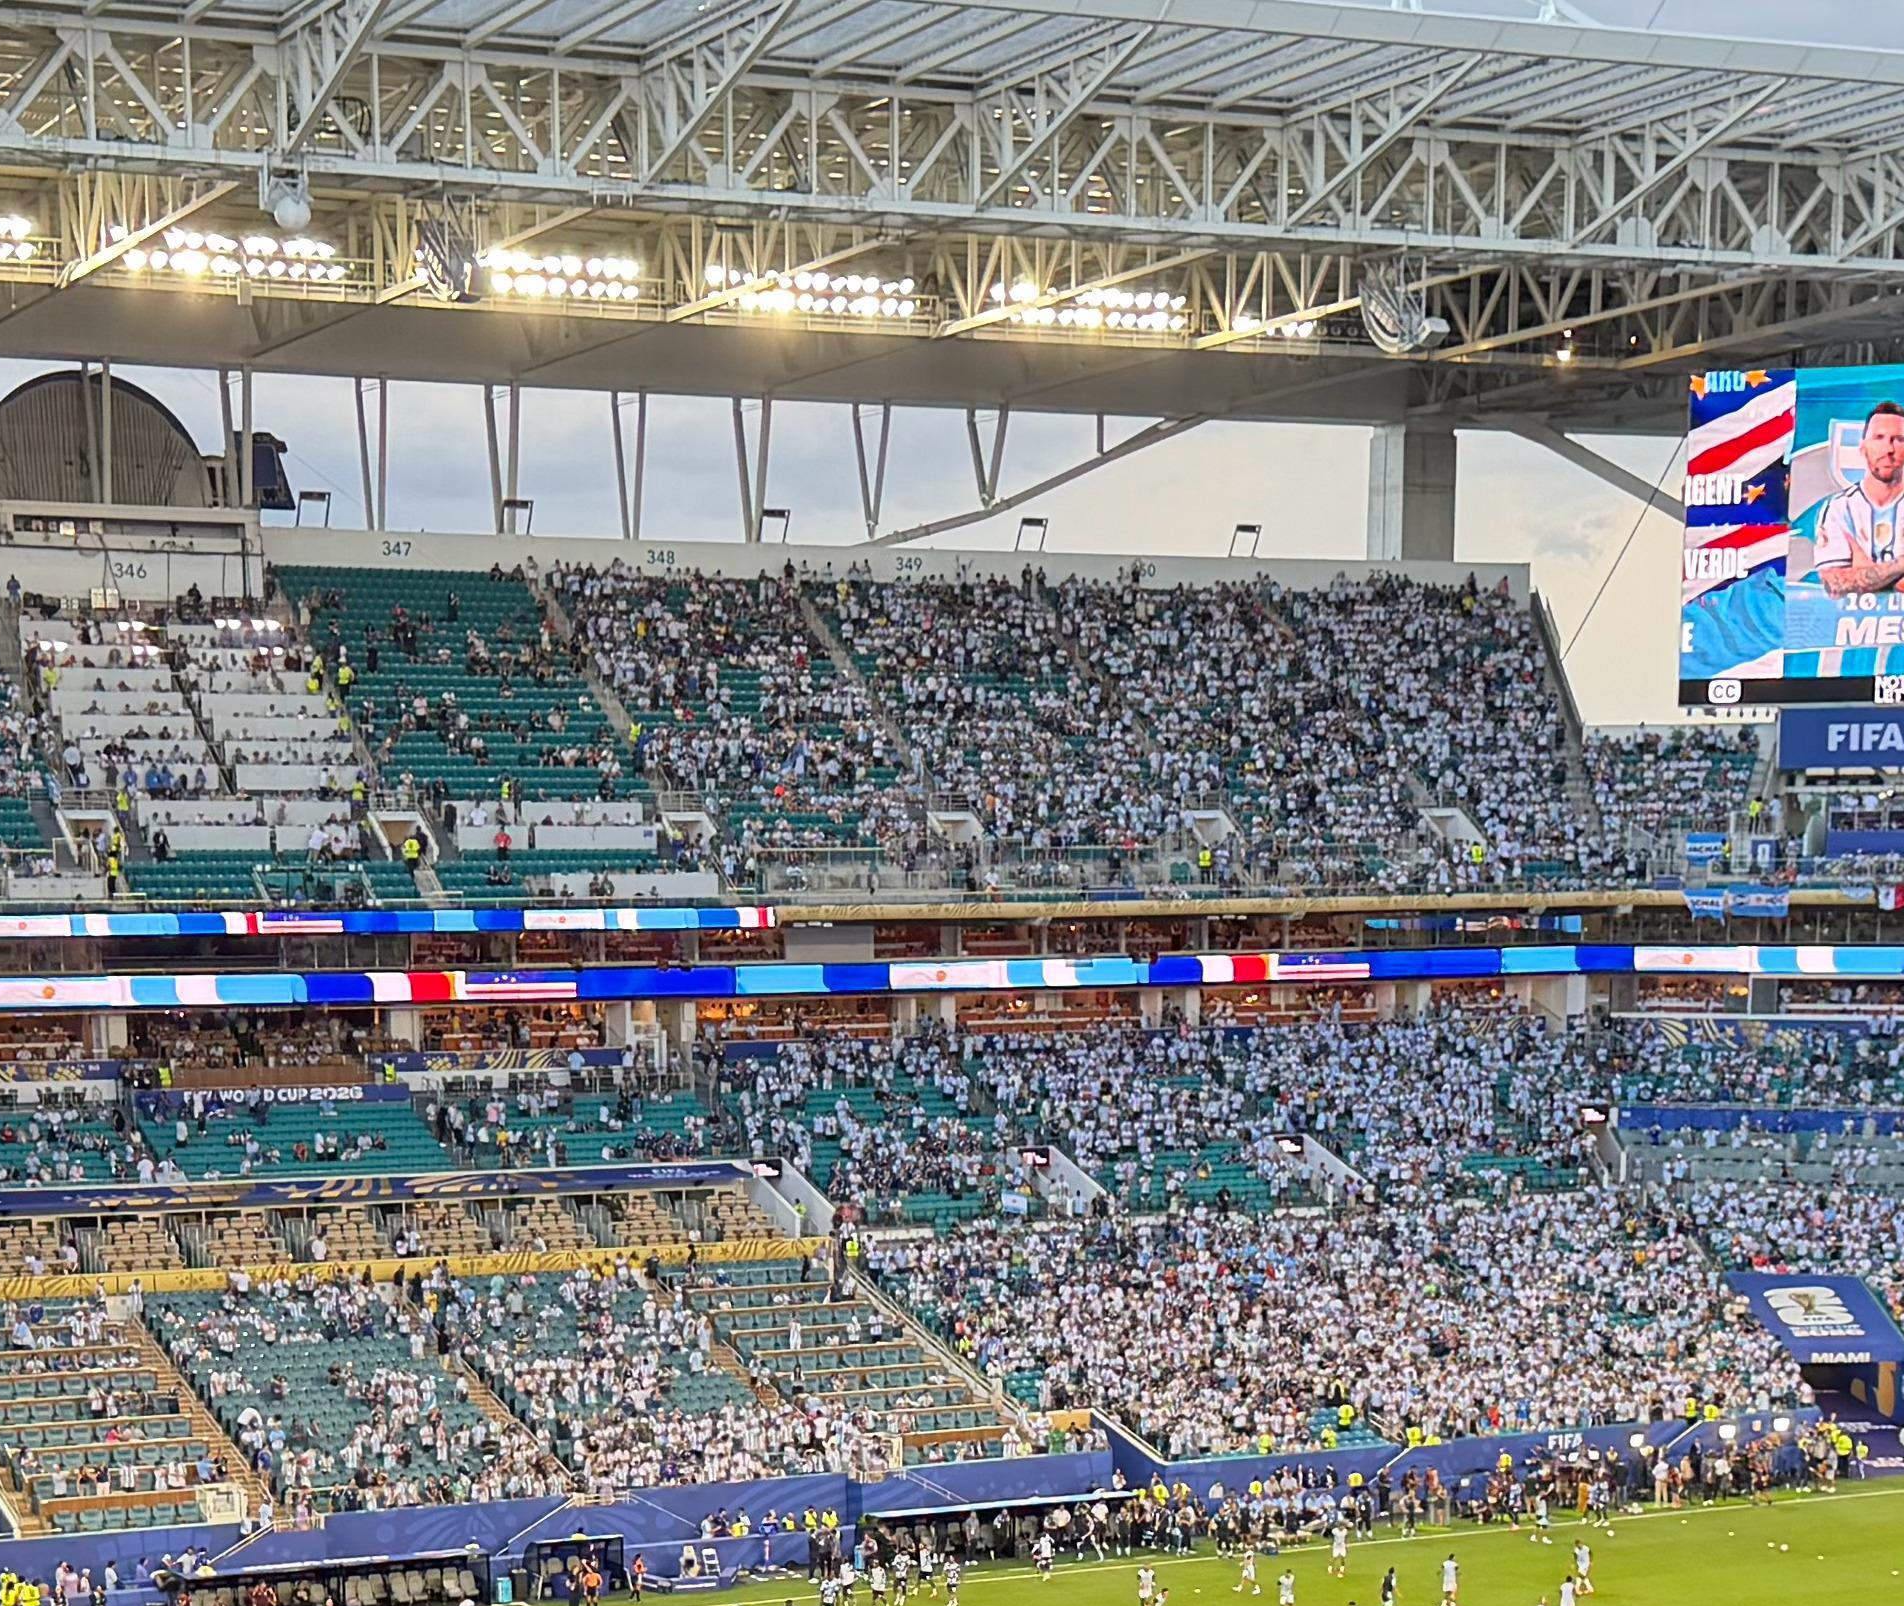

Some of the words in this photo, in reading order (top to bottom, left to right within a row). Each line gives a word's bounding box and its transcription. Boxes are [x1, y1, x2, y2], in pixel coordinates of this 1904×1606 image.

[382, 541, 411, 556] 347
[647, 550, 675, 564] 348
[896, 557, 923, 571] 349
[1683, 548, 1749, 580] VERDE
[114, 563, 147, 579] 346
[1846, 593, 1881, 611] 10.
[1712, 684, 1735, 699] CC
[1826, 723, 1904, 751] FIFA
[277, 1088, 309, 1101] CUP
[310, 1086, 364, 1101] 2026
[1811, 1352, 1871, 1364] MIAMI
[1547, 1433, 1583, 1450] FIFA
